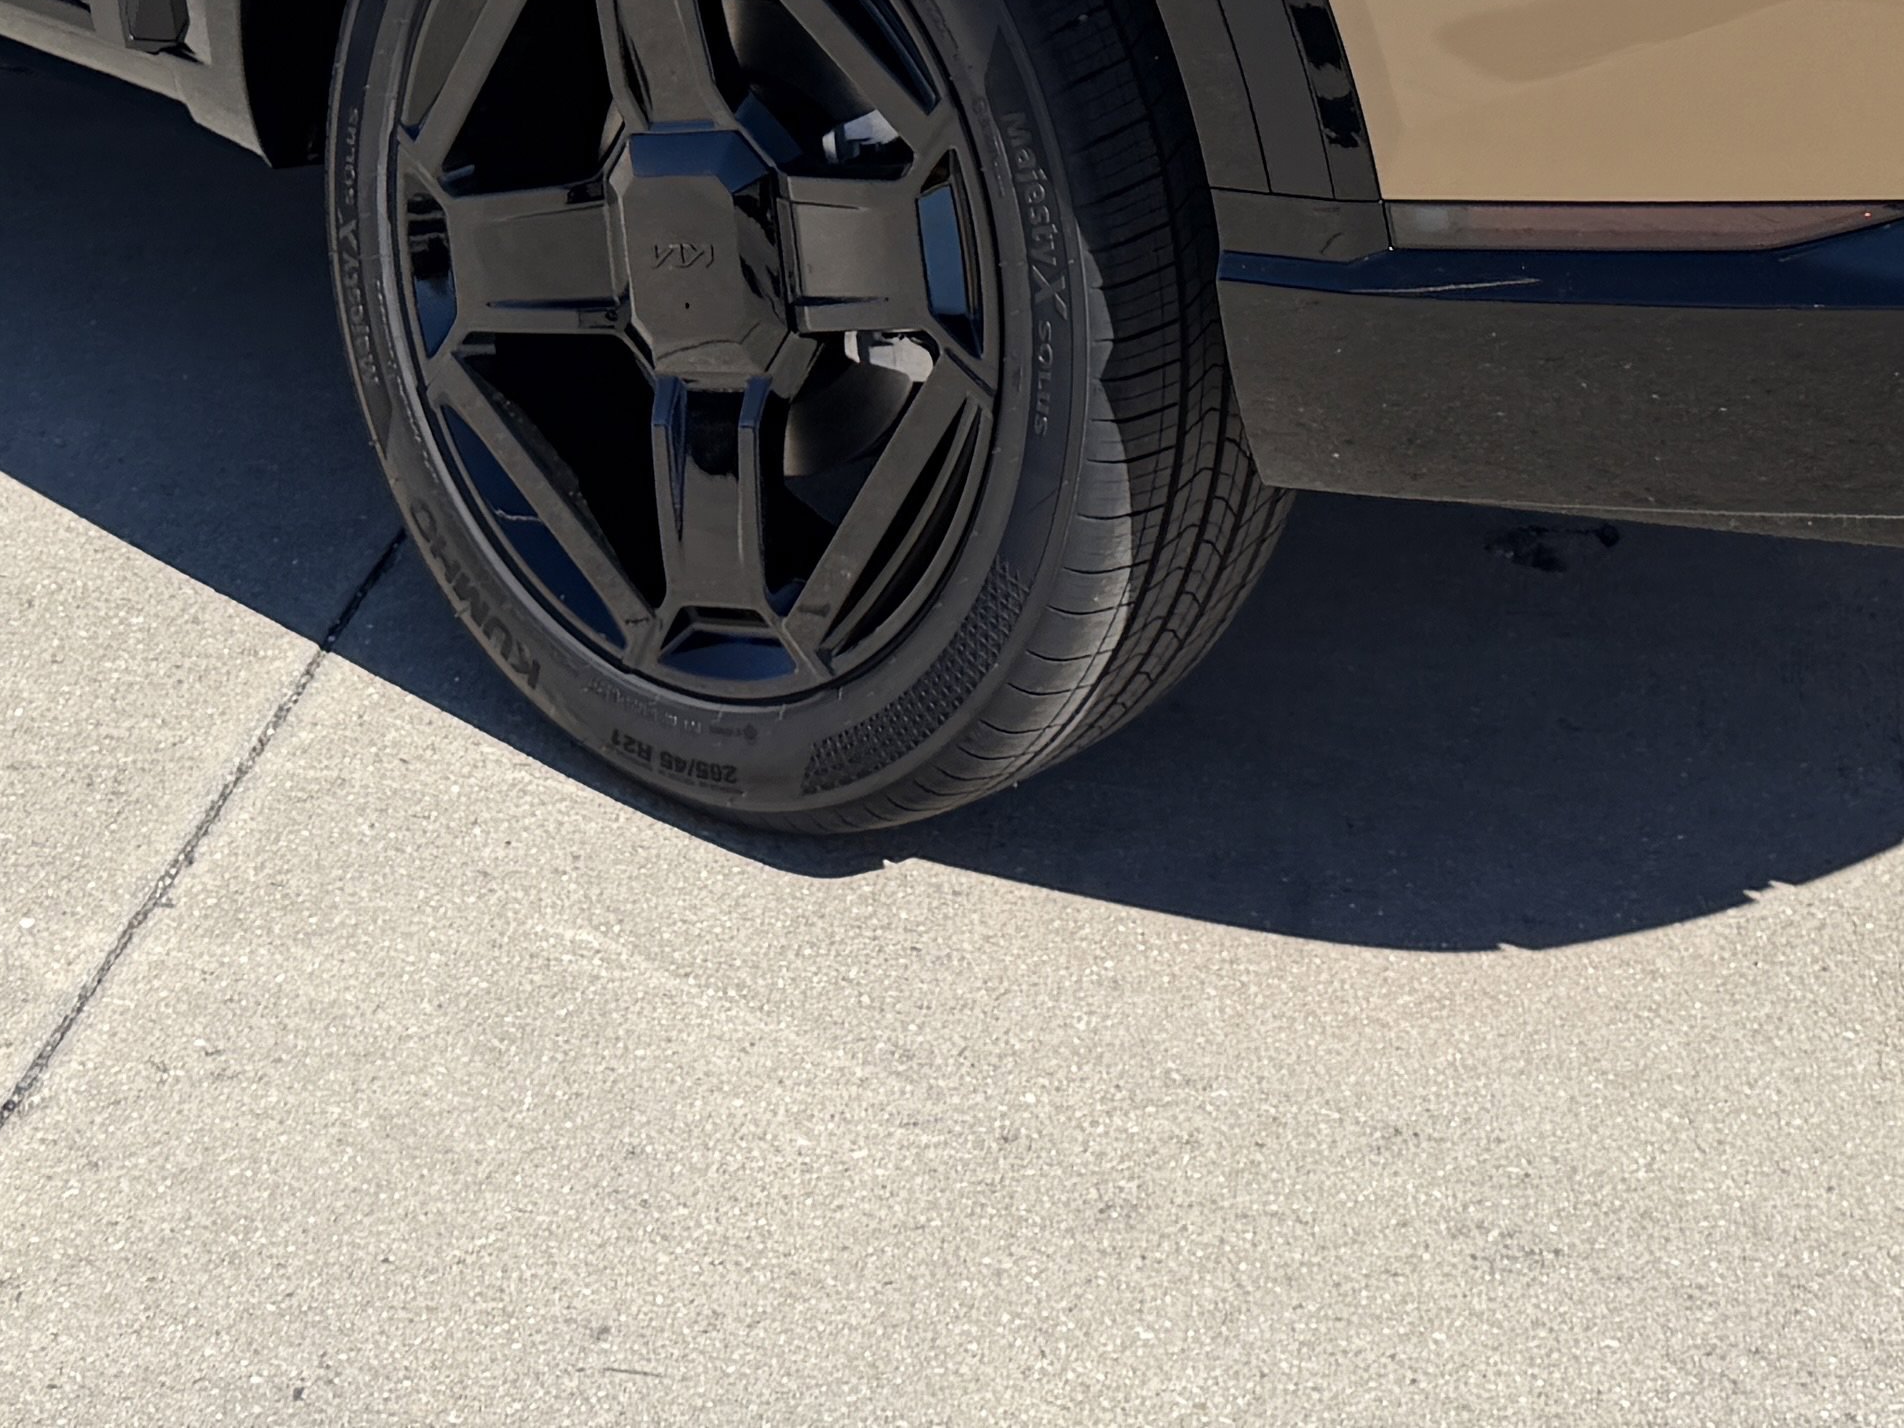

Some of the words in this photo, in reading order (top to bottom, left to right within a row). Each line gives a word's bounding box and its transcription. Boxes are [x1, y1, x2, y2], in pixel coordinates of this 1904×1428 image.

[409, 497, 543, 691] KUMHO
[609, 727, 653, 763] R21
[658, 750, 739, 786] 265/45
